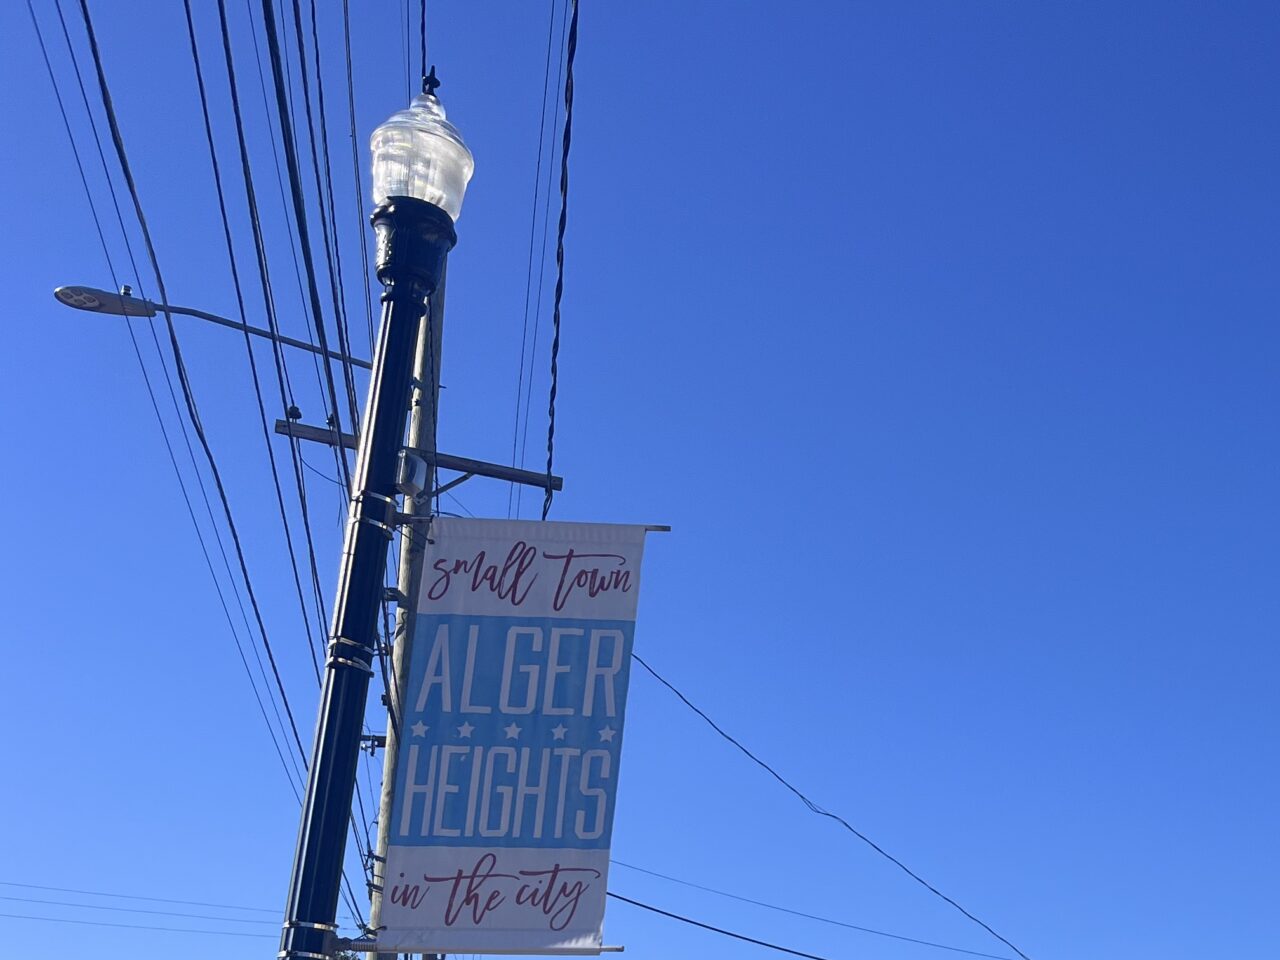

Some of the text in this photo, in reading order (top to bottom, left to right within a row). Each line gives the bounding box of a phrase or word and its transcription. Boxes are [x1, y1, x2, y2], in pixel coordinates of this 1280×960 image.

[428, 540, 539, 606] small
[414, 624, 625, 718] ALGER
[399, 745, 611, 840] HEIGHTS
[390, 853, 601, 931] in the city
